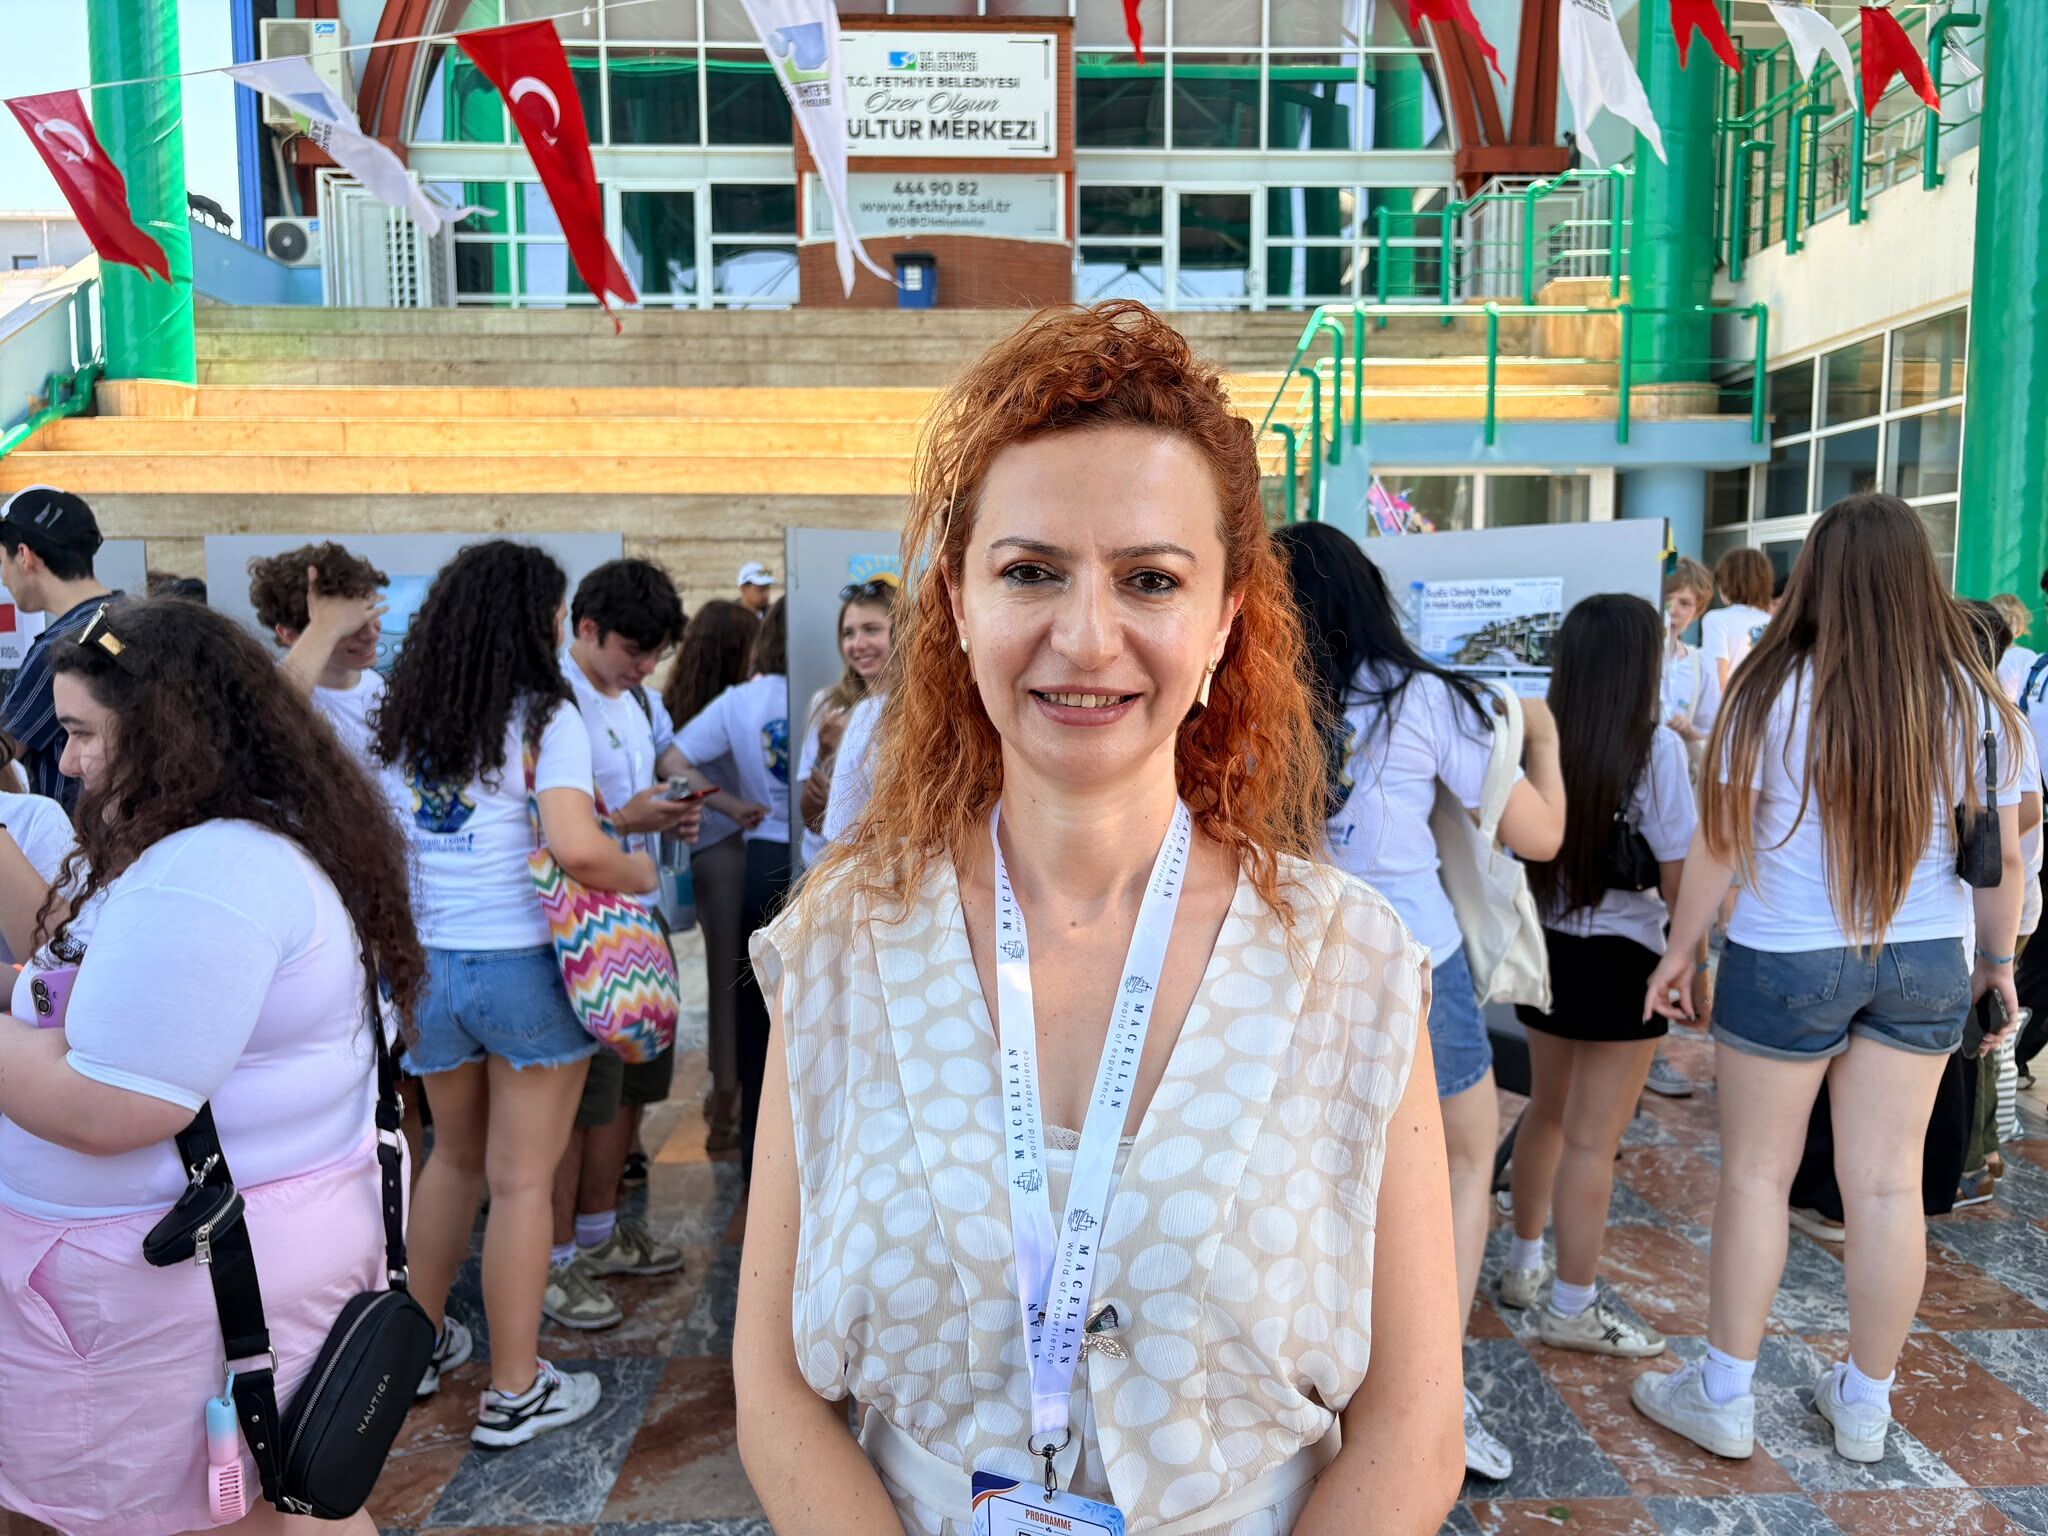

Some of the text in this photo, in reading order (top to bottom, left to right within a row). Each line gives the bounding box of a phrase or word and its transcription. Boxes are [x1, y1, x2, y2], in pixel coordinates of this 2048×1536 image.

[864, 88, 924, 114] Özer
[926, 91, 1001, 119] Olgun
[893, 181, 979, 196] 444 90 82
[1117, 1001, 1130, 1030] world
[1098, 1048, 1118, 1106] experience
[1111, 1003, 1145, 1109] MACELLAN
[1008, 1048, 1025, 1160] MACELLAN
[1023, 1049, 1037, 1159] world of experience
[1047, 1241, 1074, 1366] world of experience
[1059, 1243, 1090, 1365] MACELLAN
[356, 1374, 391, 1434] NAUTICA
[1025, 1508, 1072, 1531] PROGRAMME
